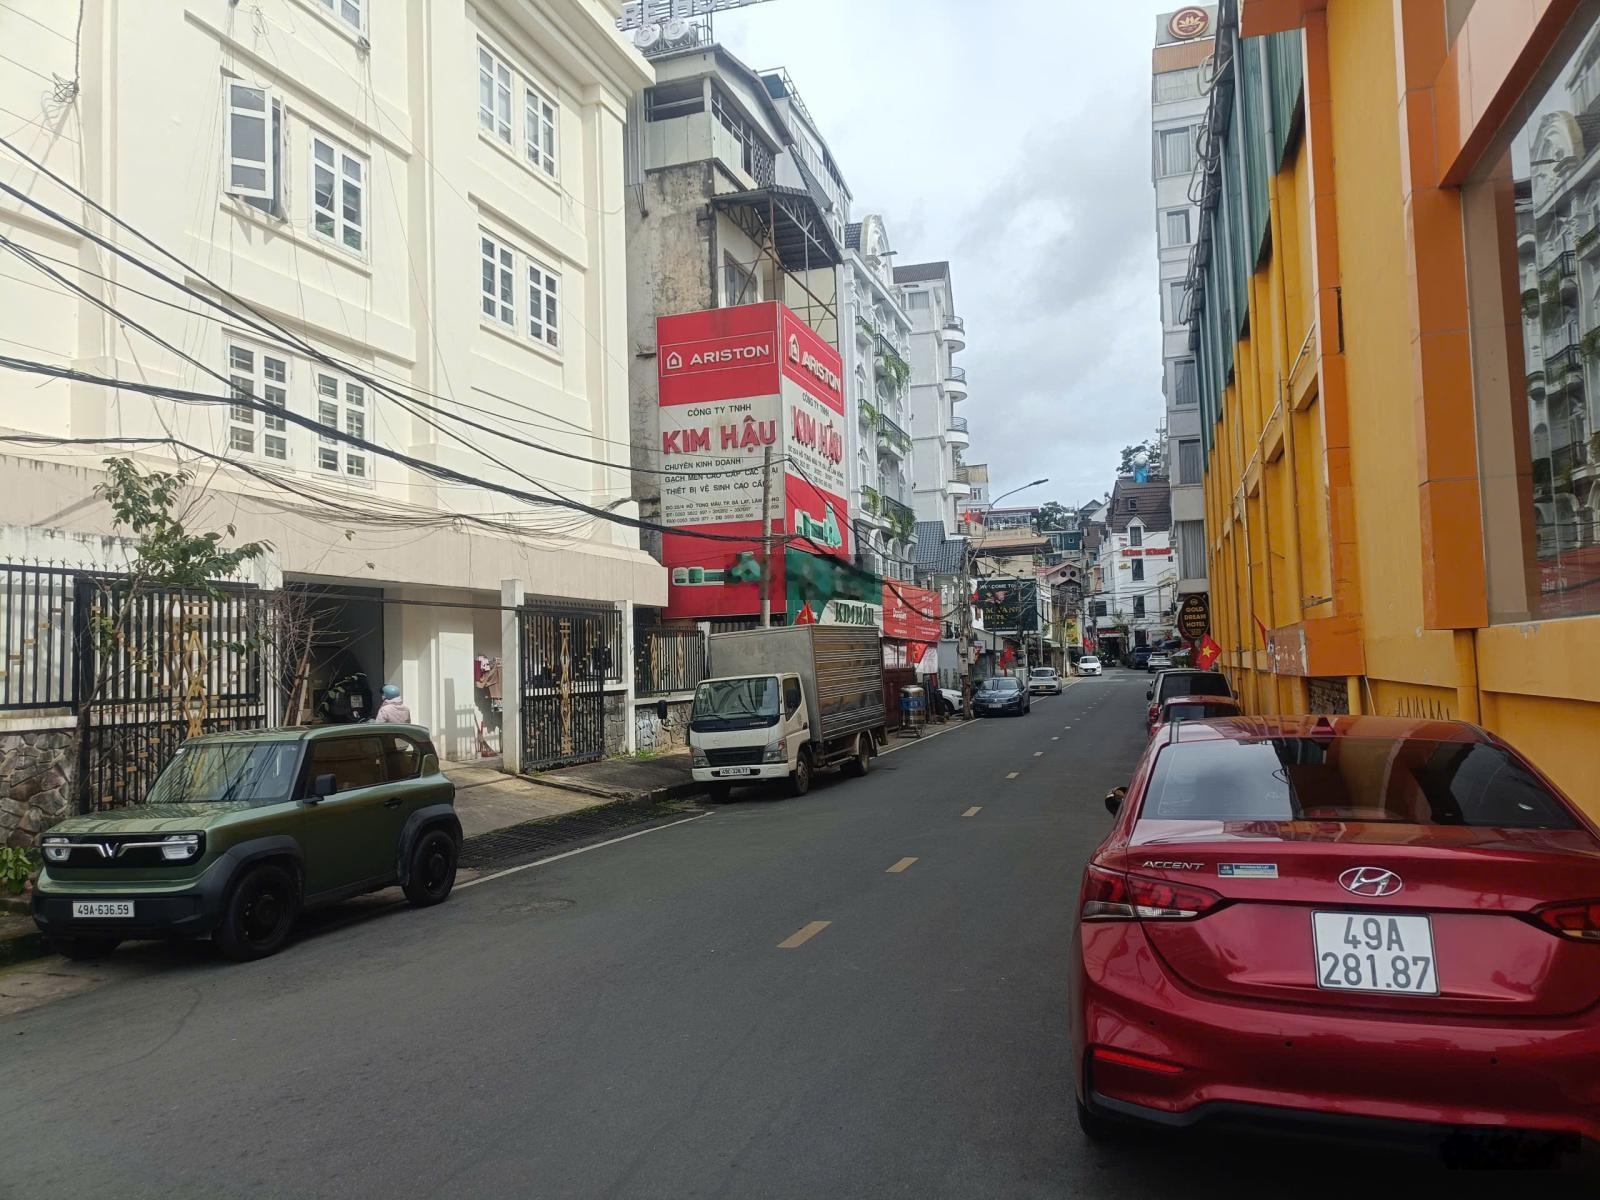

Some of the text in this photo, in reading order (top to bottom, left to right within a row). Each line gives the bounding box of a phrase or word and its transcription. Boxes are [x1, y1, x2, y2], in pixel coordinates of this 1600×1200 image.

[690, 344, 769, 366] ARISTON
[801, 351, 840, 393] ARISTON
[688, 403, 752, 417] CÔNG TY TNHH
[663, 415, 777, 455] KIM HẬU
[791, 405, 816, 451] KIM
[664, 461, 694, 471] CHUYÊN
[695, 459, 713, 468] KINH
[690, 485, 697, 495] BỊ
[713, 484, 730, 492] SINH
[734, 482, 749, 490] CAO
[834, 601, 855, 624] KIM
[1142, 861, 1205, 870] ACCENT
[77, 904, 129, 915] 49A-636.59
[1343, 917, 1405, 952] 49A
[1321, 952, 1431, 990] 281.87
